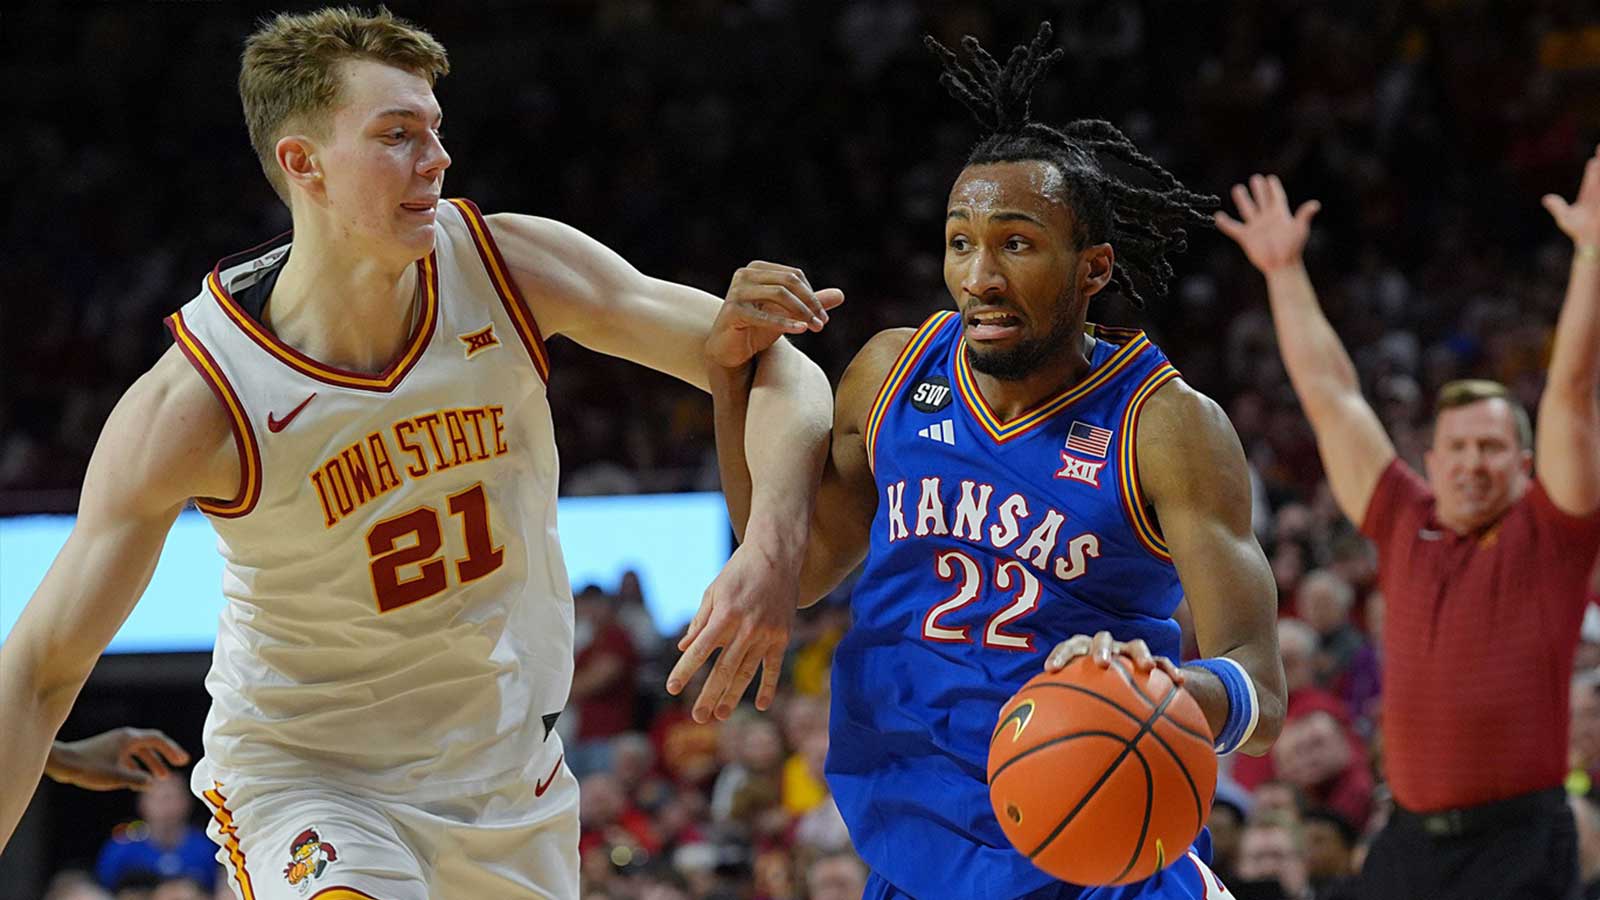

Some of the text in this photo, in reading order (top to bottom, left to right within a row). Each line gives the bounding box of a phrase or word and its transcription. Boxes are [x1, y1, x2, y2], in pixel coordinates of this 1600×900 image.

[913, 381, 950, 407] SW
[308, 404, 508, 529] IOWA STATE
[1056, 452, 1106, 487] XII
[365, 480, 505, 614] 21
[886, 476, 1100, 581] KANSAS
[922, 550, 1042, 651] 22
